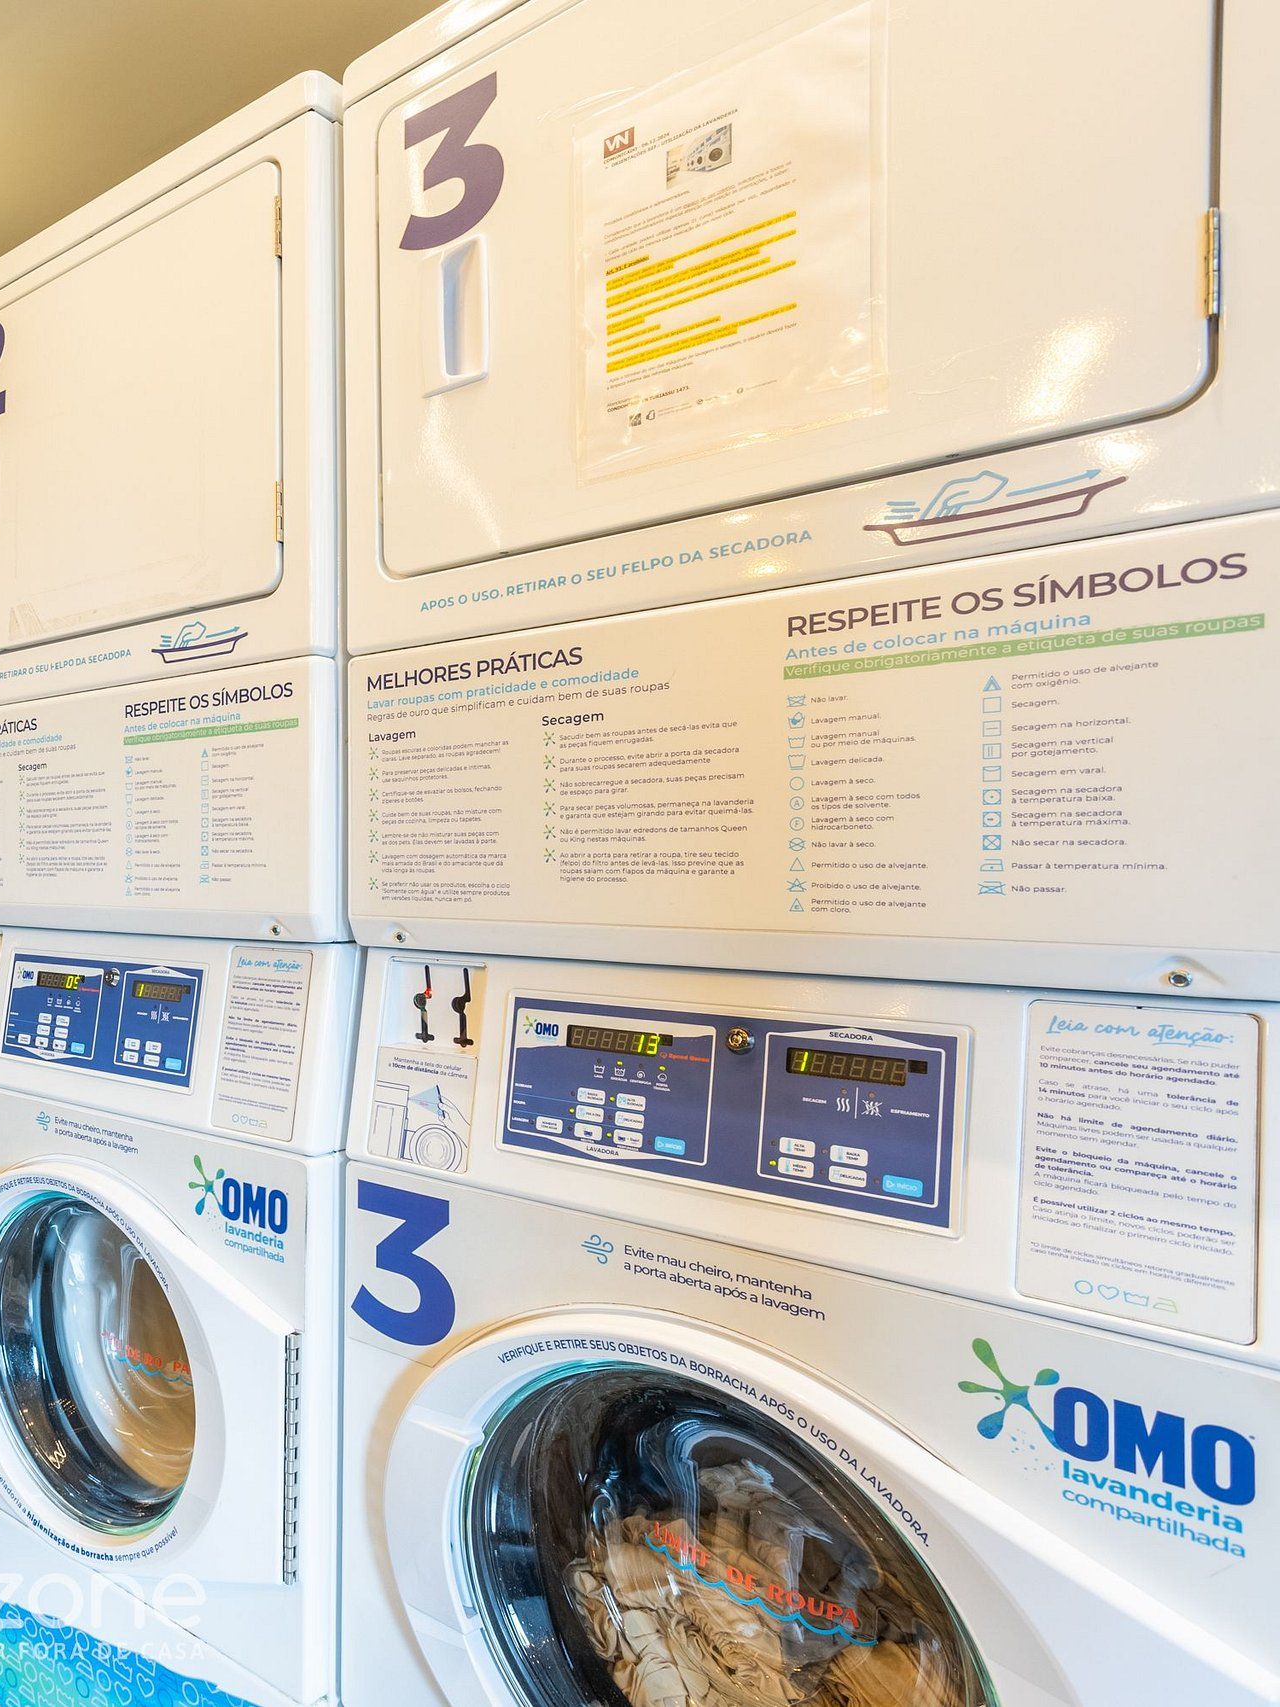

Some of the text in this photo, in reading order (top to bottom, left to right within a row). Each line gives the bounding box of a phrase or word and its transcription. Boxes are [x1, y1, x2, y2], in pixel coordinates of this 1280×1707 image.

[399, 71, 504, 251] 3
[458, 593, 468, 605] O
[506, 574, 567, 597] RETIRAR
[570, 572, 582, 585] O
[587, 565, 616, 582] SEU
[621, 555, 673, 576] FELPO
[679, 549, 703, 565] DA
[709, 529, 812, 560] SECADORA
[787, 553, 1248, 638] RESPEITE OS SÍMBOLOS
[784, 618, 1262, 677] Verifique obrigatoriamente a etiqueta de suas roupas
[785, 616, 1092, 660] Antes de colocar na máquina
[366, 647, 584, 693] MELHORES PRÁTICAS
[366, 668, 639, 709] Lavar roupas com praticidade e comodidade
[124, 682, 294, 719] RESPEITE OS SÍMBOLOS
[541, 713, 605, 726] Secagem
[368, 731, 416, 743] Lavagem
[1011, 723, 1056, 731] Secagem
[1075, 717, 1132, 728] horizontal.
[18, 761, 48, 772] Secagem
[1045, 862, 1050, 870] à
[1053, 862, 1118, 871] temperatura
[1122, 862, 1168, 870] mínima.
[1011, 885, 1030, 893] Não
[22, 970, 34, 980] OMO
[535, 1022, 559, 1037] OMO
[638, 1034, 660, 1054] 13
[829, 1031, 874, 1041] SECADORA
[1046, 1015, 1235, 1046] Leia com atenção:
[1040, 1061, 1218, 1086] 10 minutos antes do horário agendado.
[586, 1146, 619, 1156] LAVADORA
[221, 1177, 288, 1234] OMO
[224, 1222, 284, 1250] lavanderia
[224, 1238, 284, 1264] compartilhada
[352, 1180, 456, 1346] 3
[623, 1244, 812, 1299] Evite mau cheiro, mantenha
[623, 1262, 826, 1321] a porta aberta após a lavagem
[498, 1339, 930, 1548] VERIFIQUE E RETIRE SEUS OBJETOS DA BORRACHA APÓS O USO DA LAVADORA.
[1053, 1386, 1256, 1506] OMO
[1062, 1460, 1243, 1534] lavanderia
[26, 1511, 178, 1563] higienização da borracha sempre que possível
[1062, 1490, 1246, 1558] compartilhada
[767, 1582, 860, 1628] ROUPA
